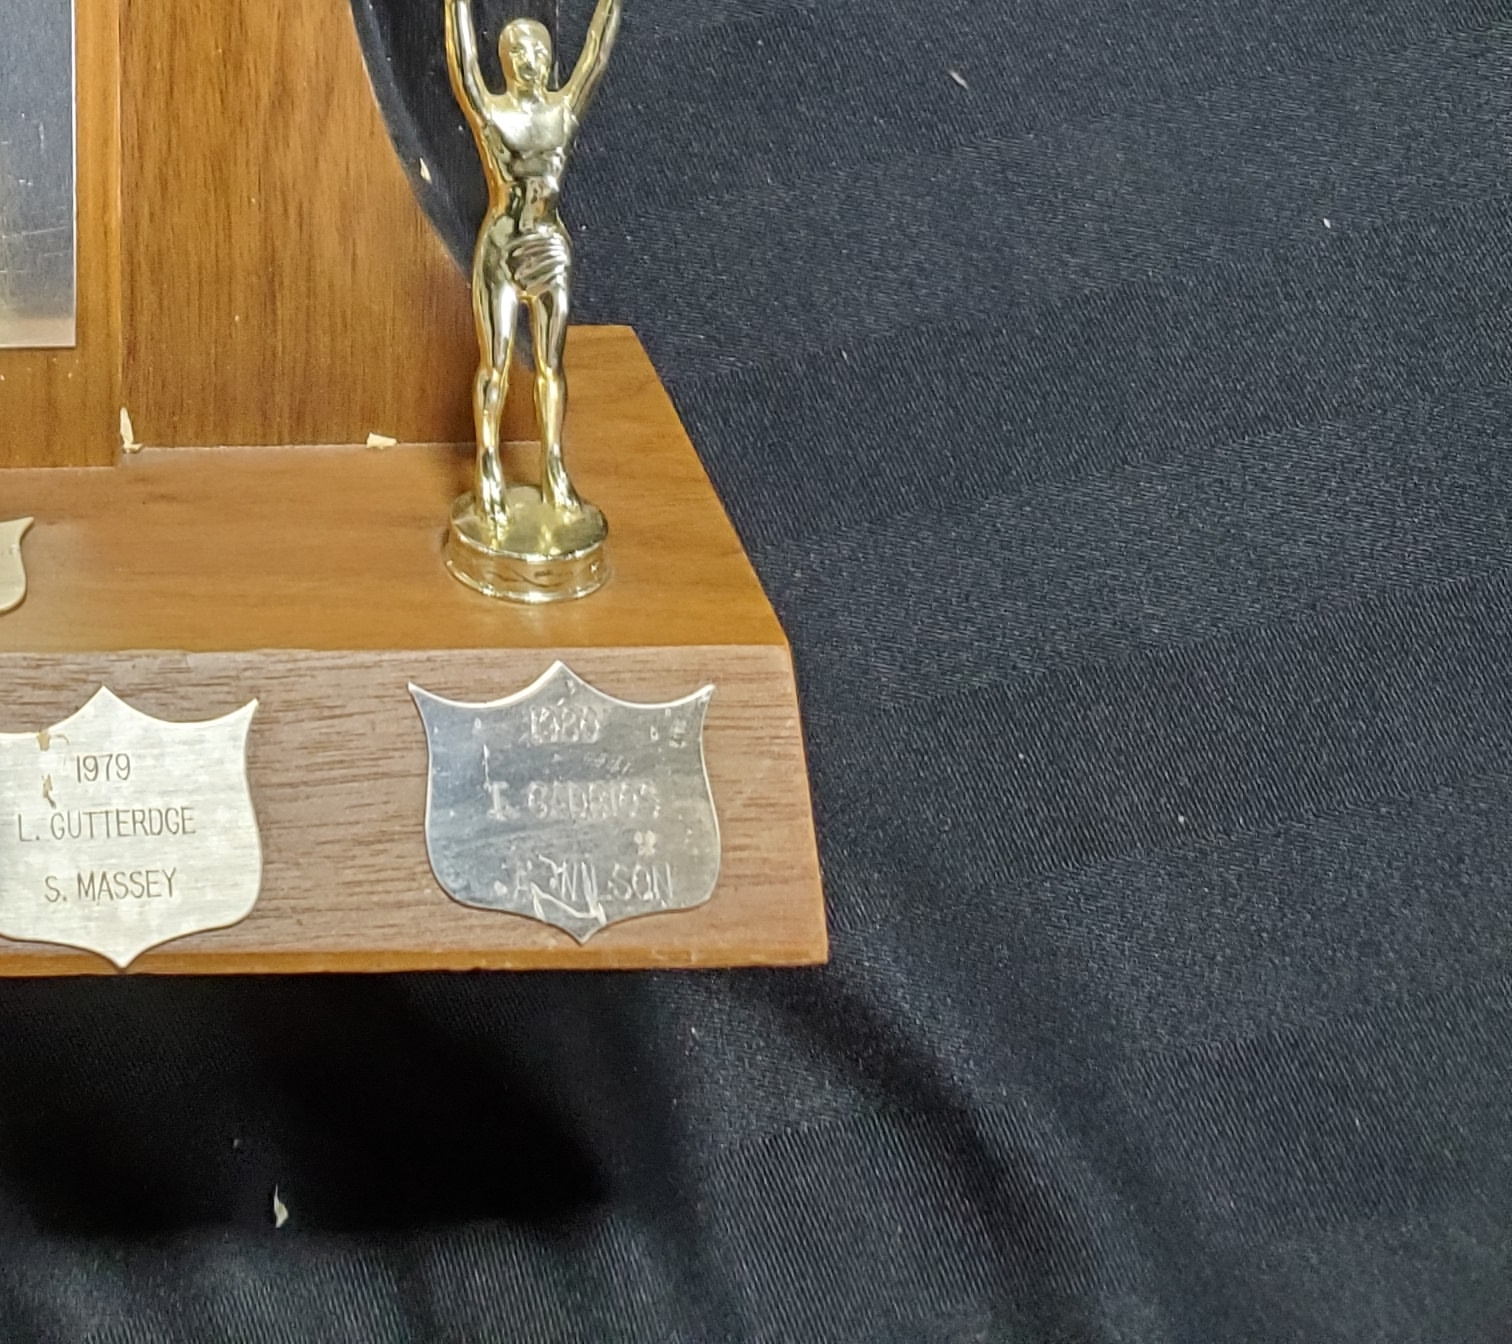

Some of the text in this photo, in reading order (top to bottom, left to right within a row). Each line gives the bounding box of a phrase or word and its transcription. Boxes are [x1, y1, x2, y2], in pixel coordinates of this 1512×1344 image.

[75, 752, 132, 784] 1979
[17, 813, 41, 843] L.
[44, 867, 178, 904] S. MASSEY
